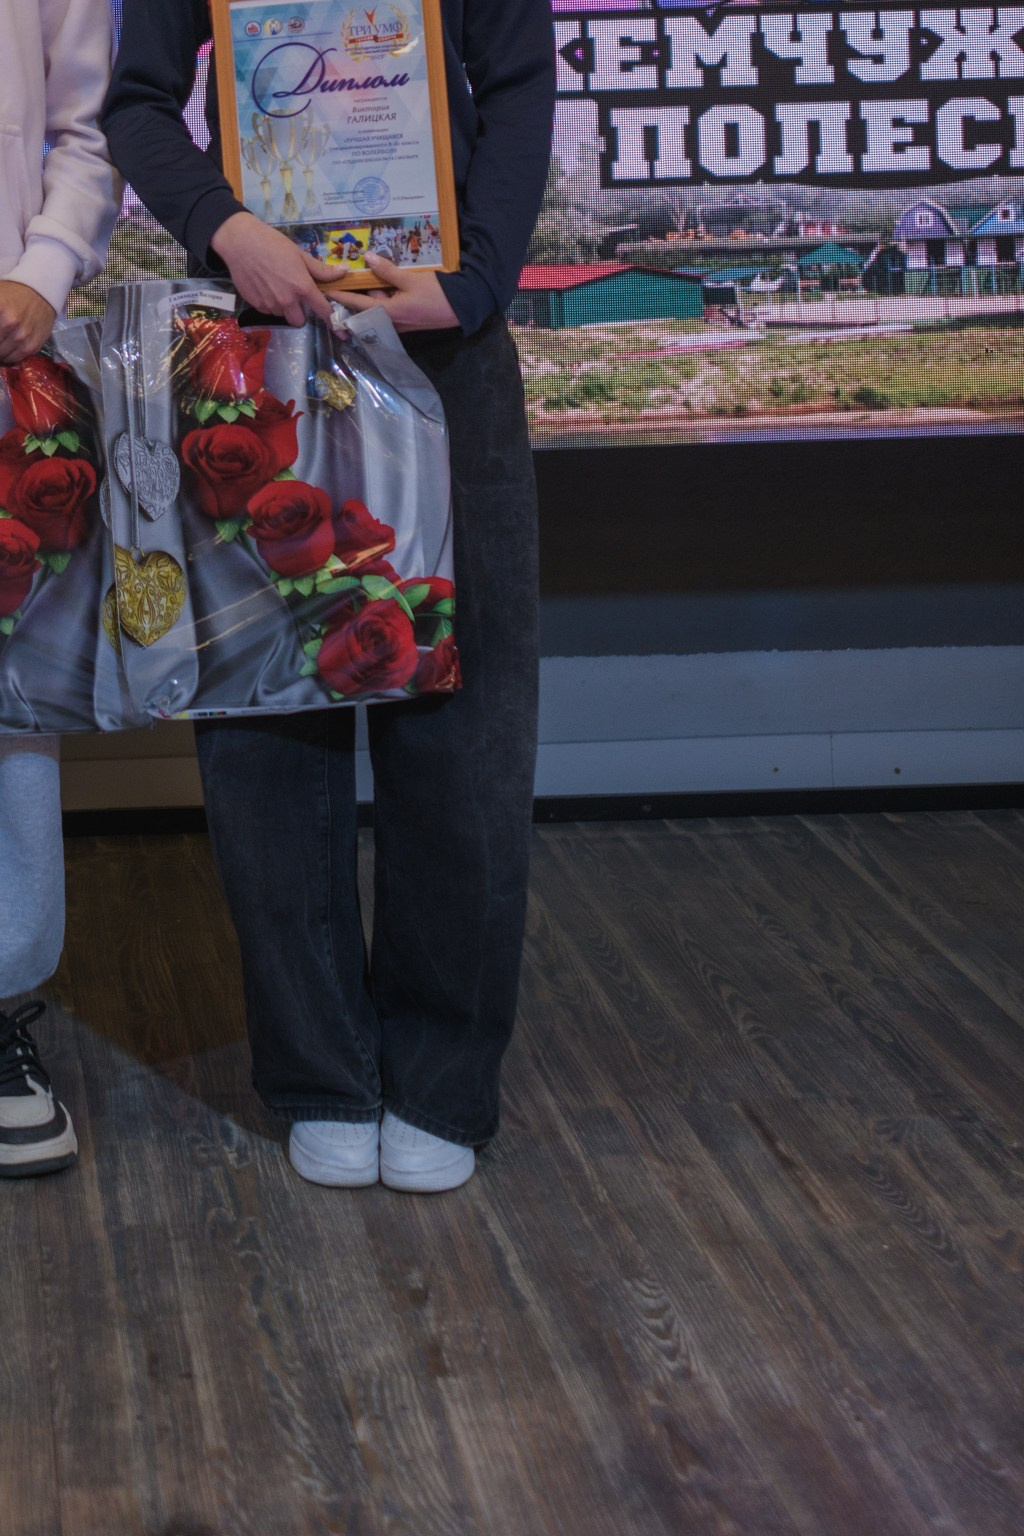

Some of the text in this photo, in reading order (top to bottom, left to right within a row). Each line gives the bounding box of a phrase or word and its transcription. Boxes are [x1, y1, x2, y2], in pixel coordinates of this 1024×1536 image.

[554, 7, 1024, 92] ЕМЧУЖ
[252, 42, 409, 118] Диплом
[347, 113, 397, 124] ГАЛИЦКАЯ
[352, 105, 390, 113] Виктория
